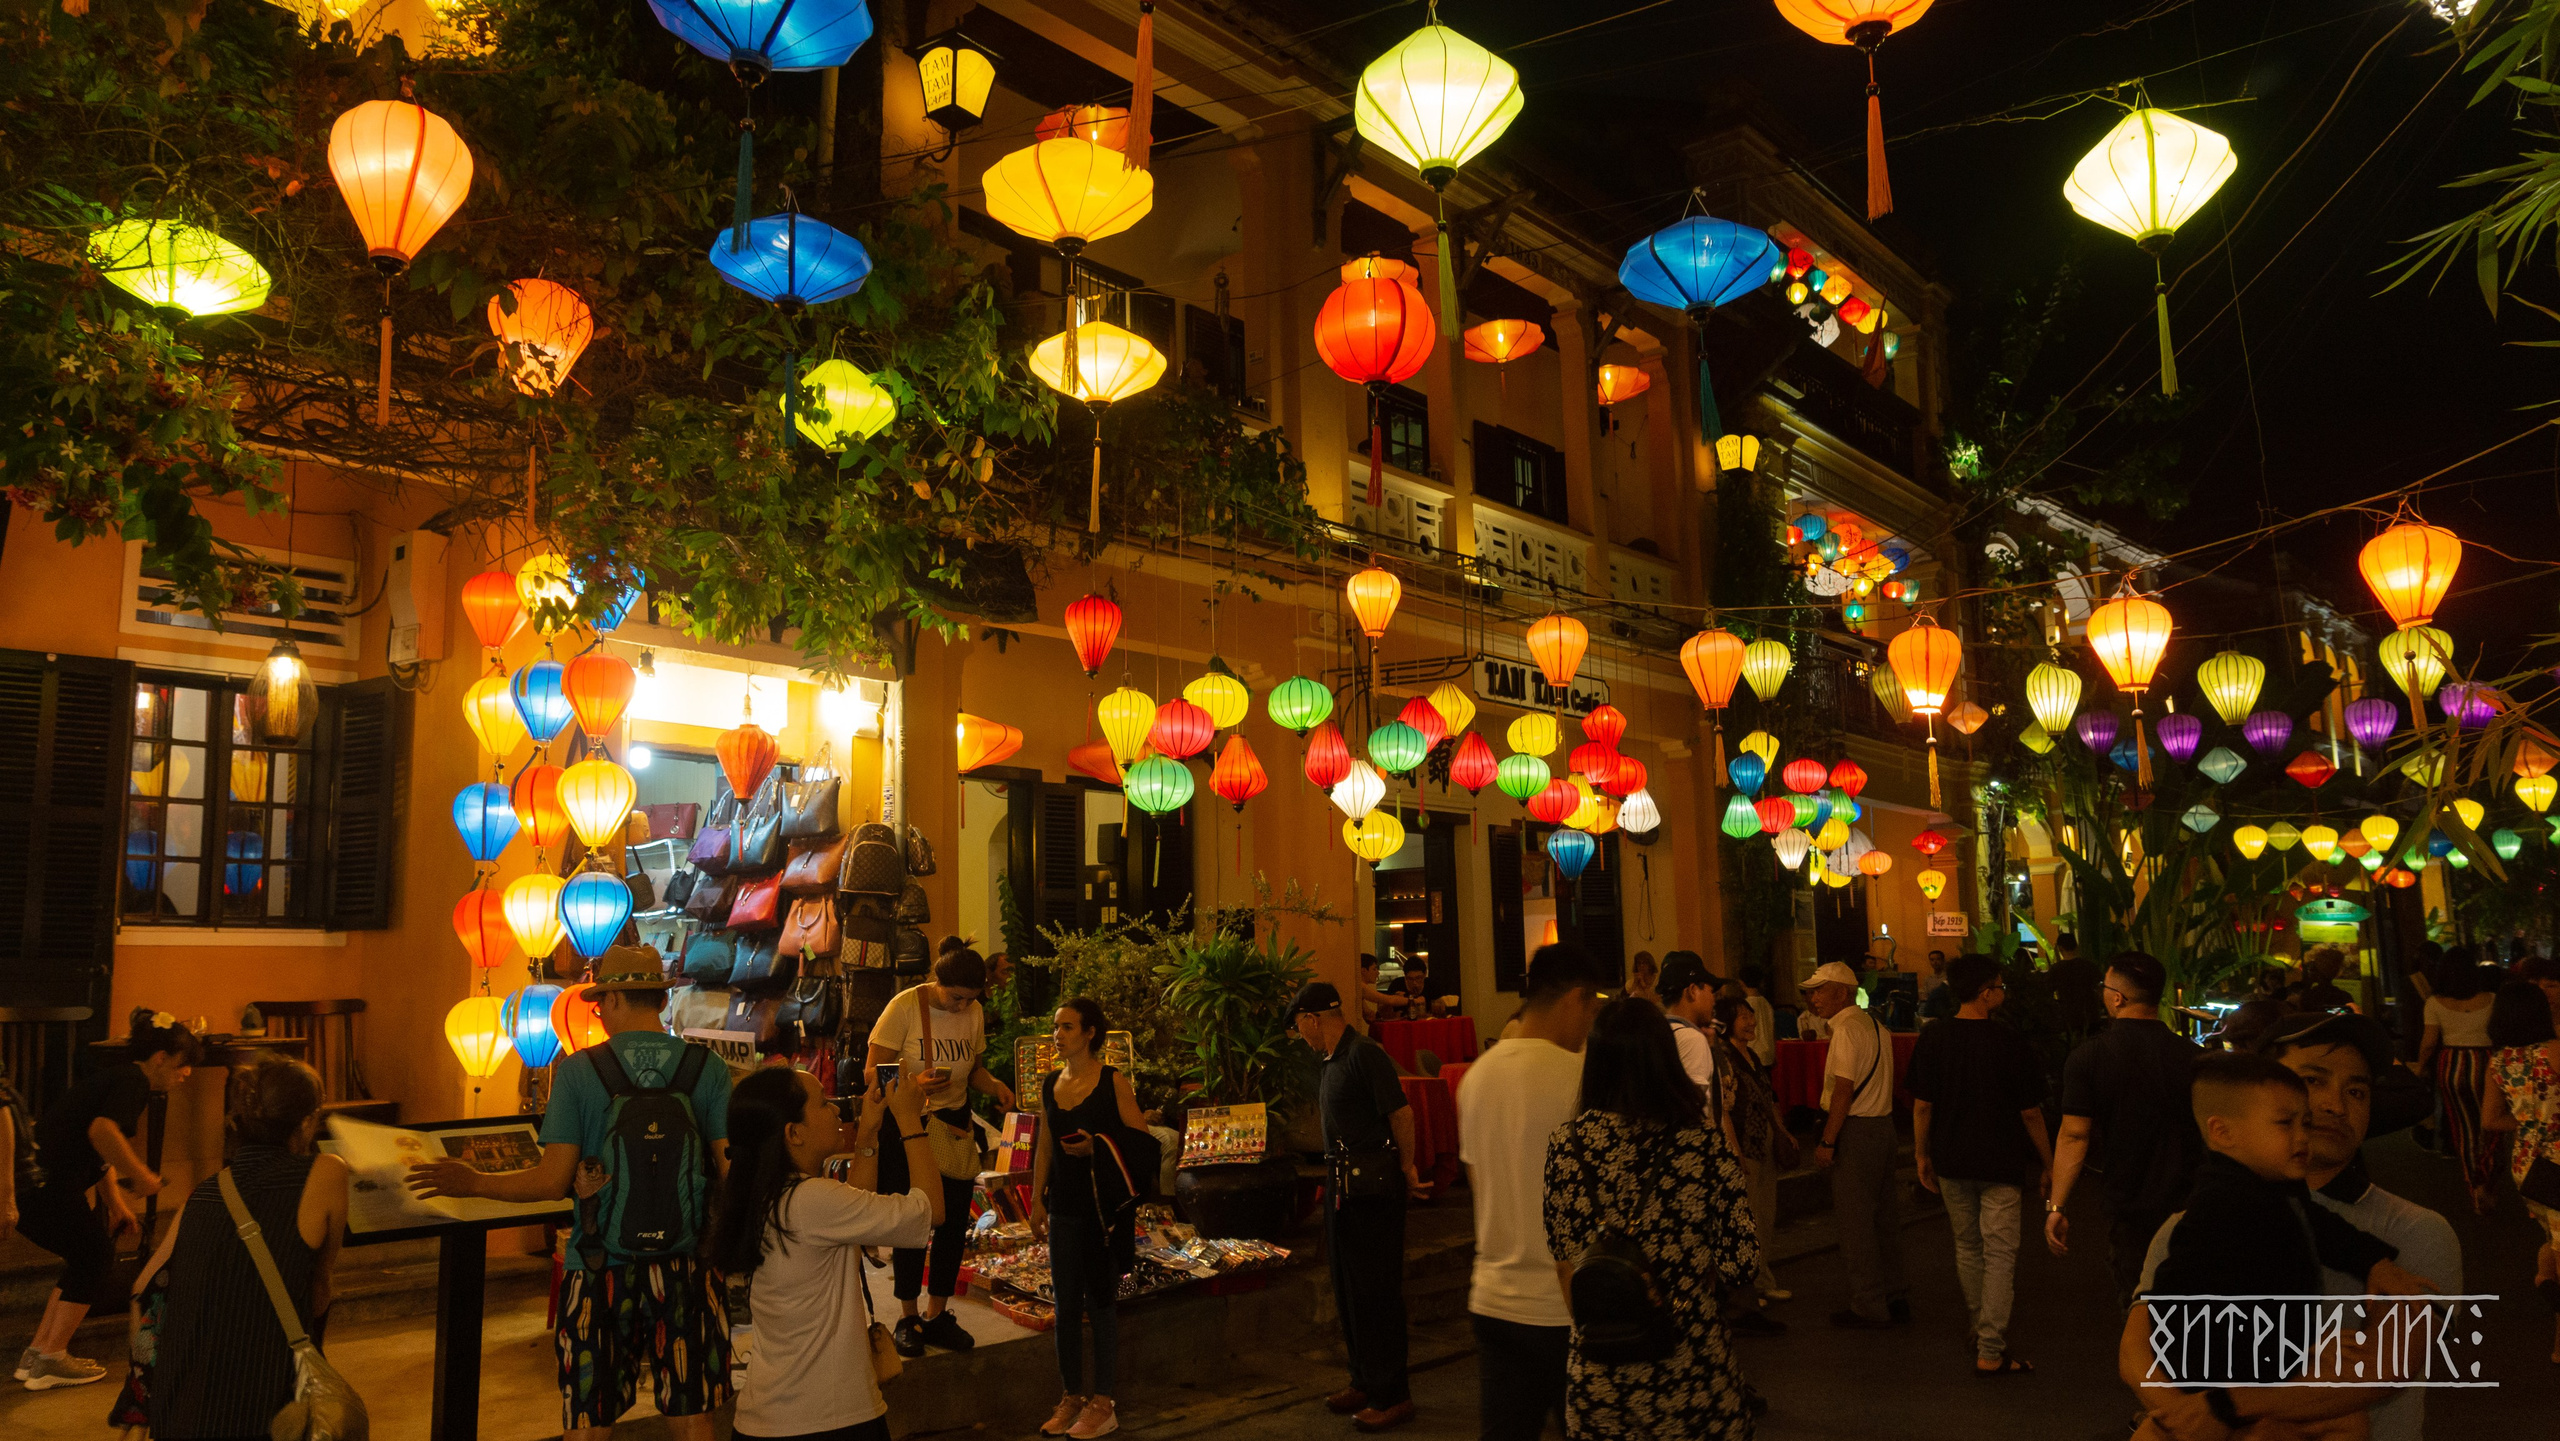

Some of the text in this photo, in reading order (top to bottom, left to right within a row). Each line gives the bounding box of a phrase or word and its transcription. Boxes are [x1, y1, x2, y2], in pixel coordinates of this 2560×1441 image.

[922, 54, 950, 77] TAM
[924, 72, 950, 94] TAM
[1947, 916, 1964, 926] 1919
[688, 1037, 750, 1064] AMP
